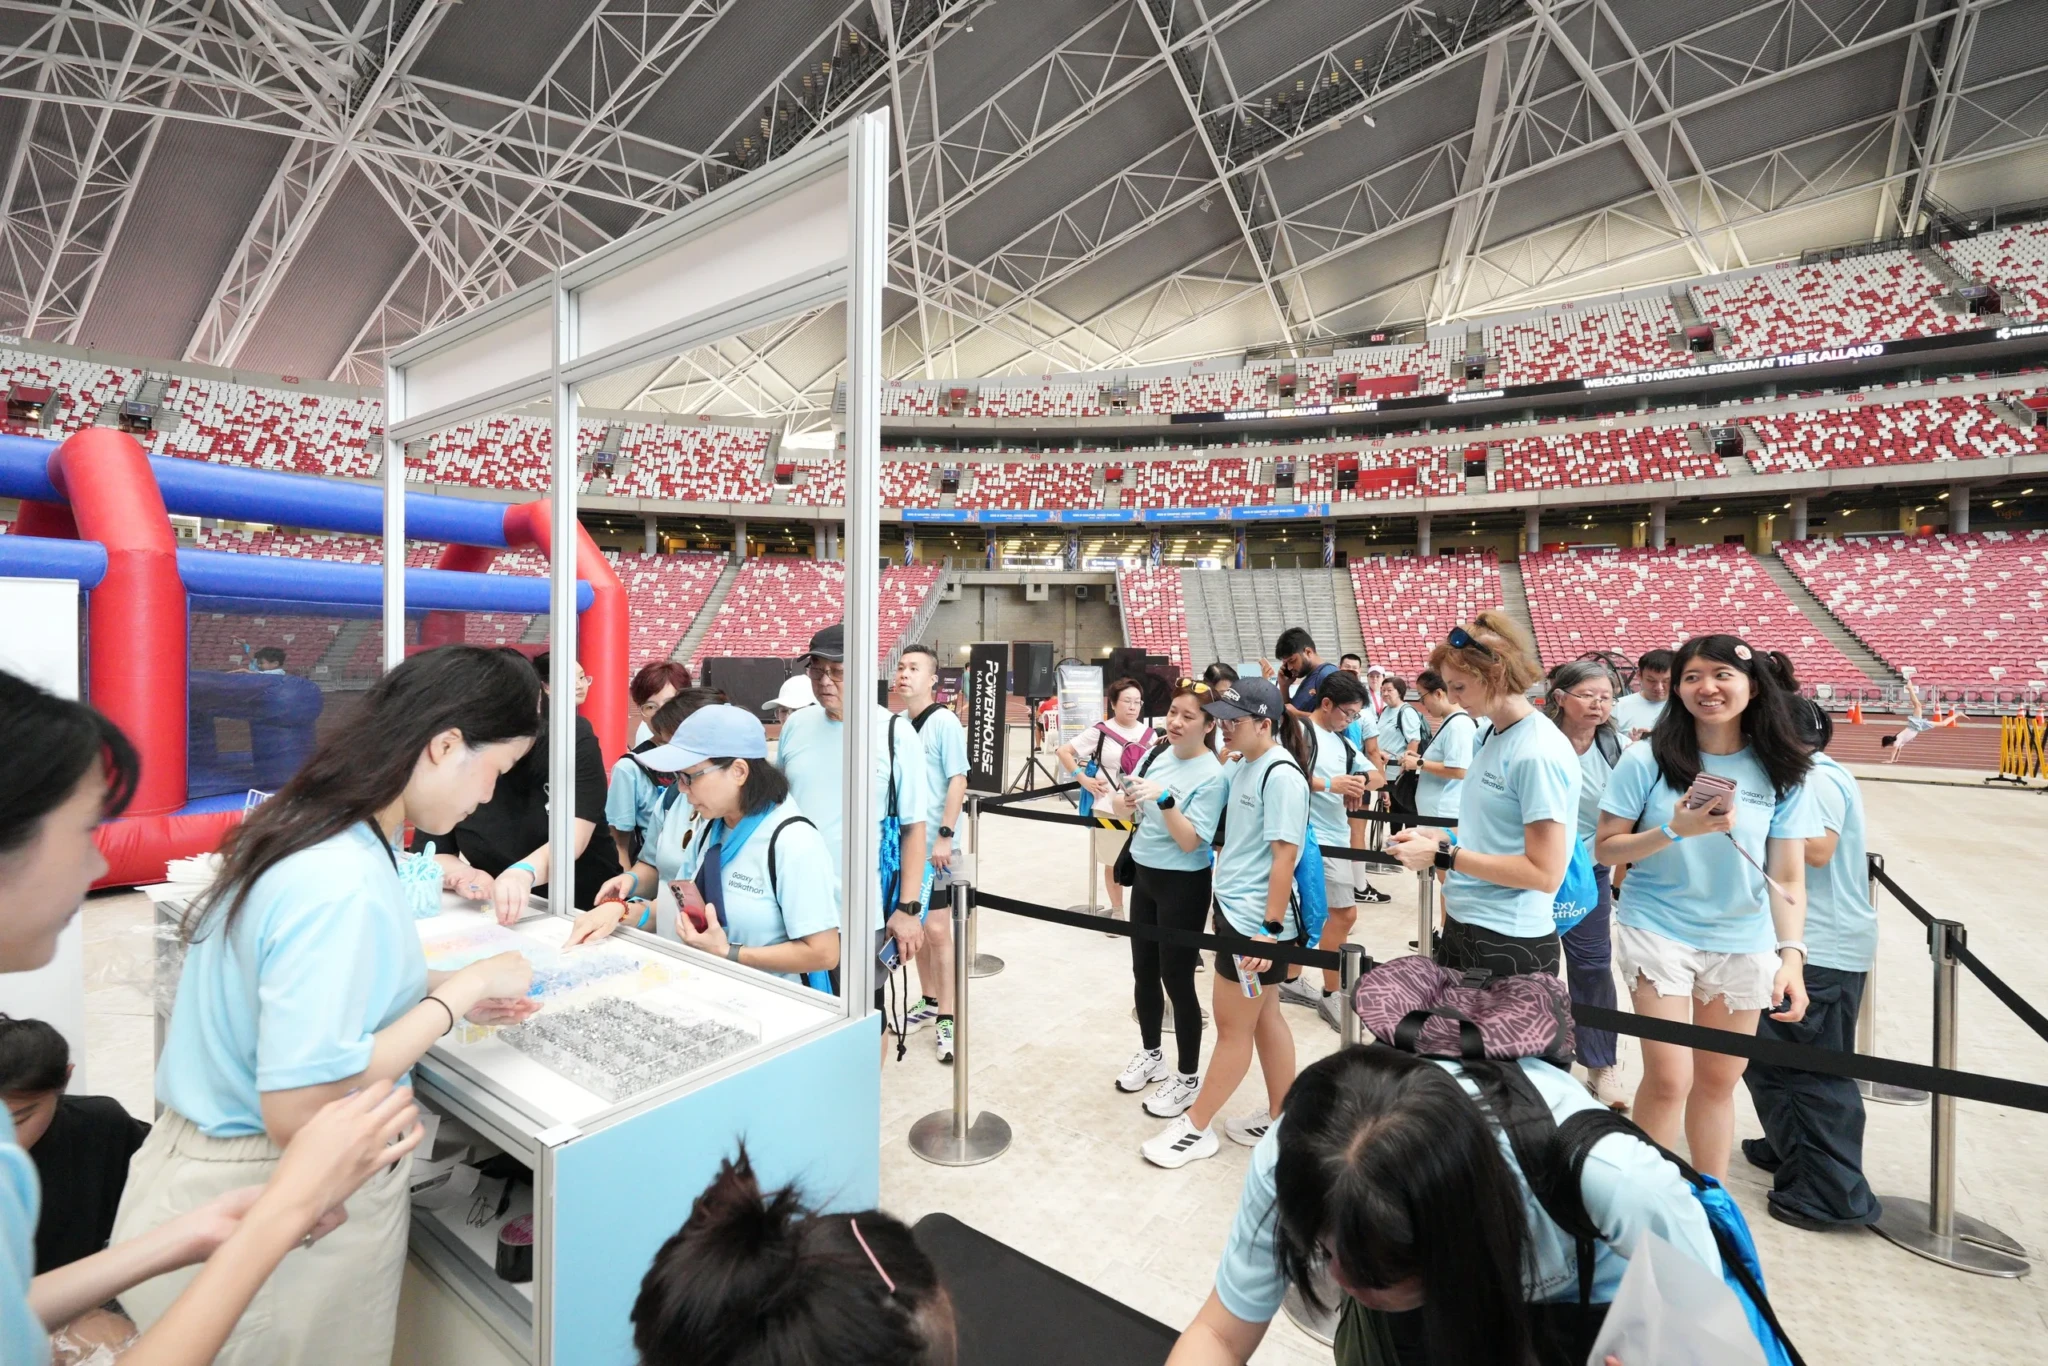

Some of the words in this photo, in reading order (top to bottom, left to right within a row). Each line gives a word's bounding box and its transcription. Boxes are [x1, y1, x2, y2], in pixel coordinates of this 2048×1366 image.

[1561, 302, 1574, 310] 616
[1370, 333, 1385, 342] 617
[1583, 374, 1637, 389] WELCOME
[1638, 373, 1651, 383] TO
[1653, 366, 1708, 382] NATIONAL
[1708, 359, 1760, 374] STADIUM
[1760, 357, 1776, 369] AT
[1777, 354, 1807, 367] THE
[1808, 344, 1884, 363] KALLANG
[281, 374, 300, 385] 423
[1846, 393, 1865, 403] 415
[699, 414, 711, 422] 421
[1599, 419, 1614, 427] 416
[1371, 439, 1384, 447] 417
[975, 670, 983, 717] KARAOKE
[981, 659, 999, 776] POWERHOUSE
[973, 720, 981, 763] SYSTEMS
[732, 872, 753, 884] Galaxy
[728, 880, 764, 895] Walkathon
[1553, 901, 1576, 911] axy
[1552, 907, 1587, 919] athon
